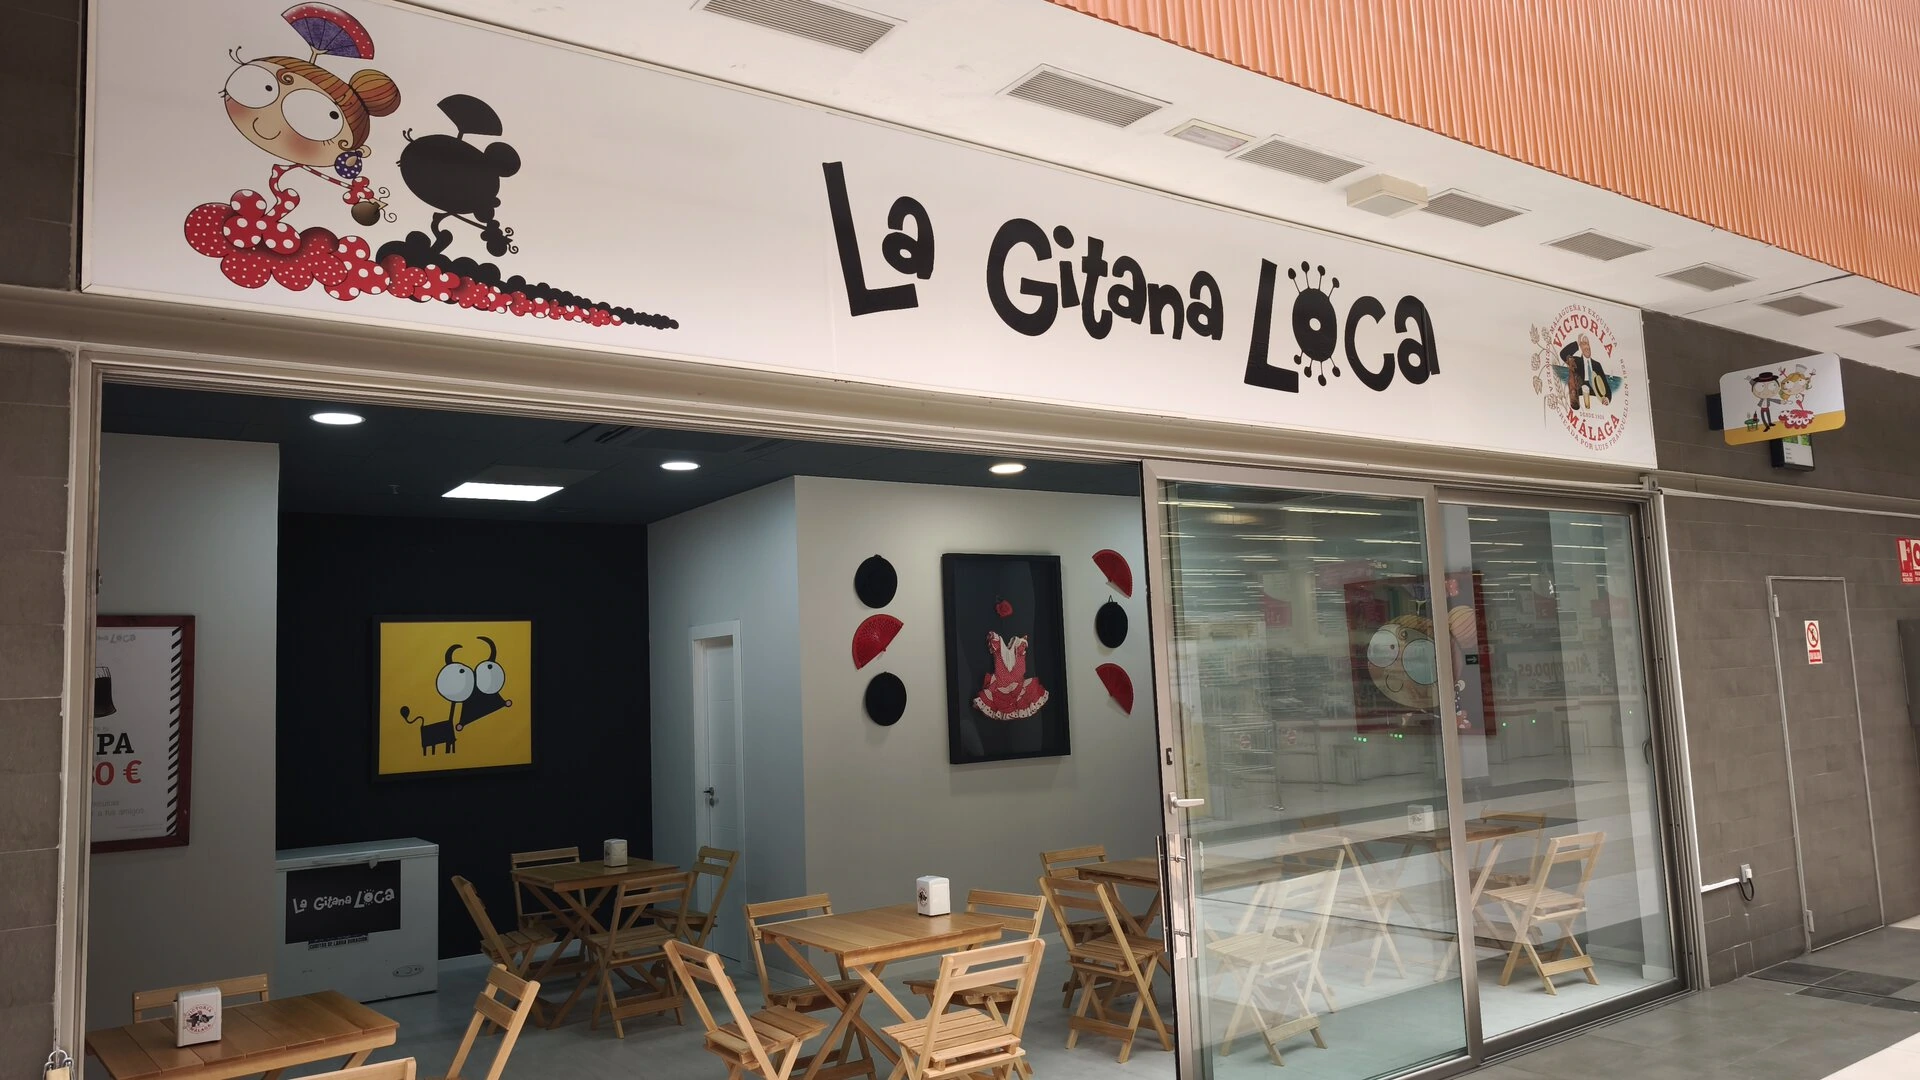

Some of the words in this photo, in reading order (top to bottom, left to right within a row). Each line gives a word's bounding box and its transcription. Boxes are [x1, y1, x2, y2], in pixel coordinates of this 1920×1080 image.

[822, 161, 935, 316] La
[986, 217, 1224, 339] Gitana
[1244, 258, 1440, 393] Loca
[1550, 304, 1582, 334] MALAGUEÑA
[1587, 308, 1618, 348] EXQUISITA
[1553, 314, 1613, 358] VICTORIA
[1566, 408, 1620, 441] MÁLAGA
[1580, 438, 1594, 451] POR
[1594, 442, 1609, 452] LUIS
[1609, 399, 1629, 446] FRANQUELO
[96, 733, 134, 756] PA
[123, 760, 142, 784] €
[293, 898, 308, 914] La
[313, 895, 352, 911] Gitana
[354, 888, 396, 909] Loca
[188, 1005, 212, 1016] VICTORIA
